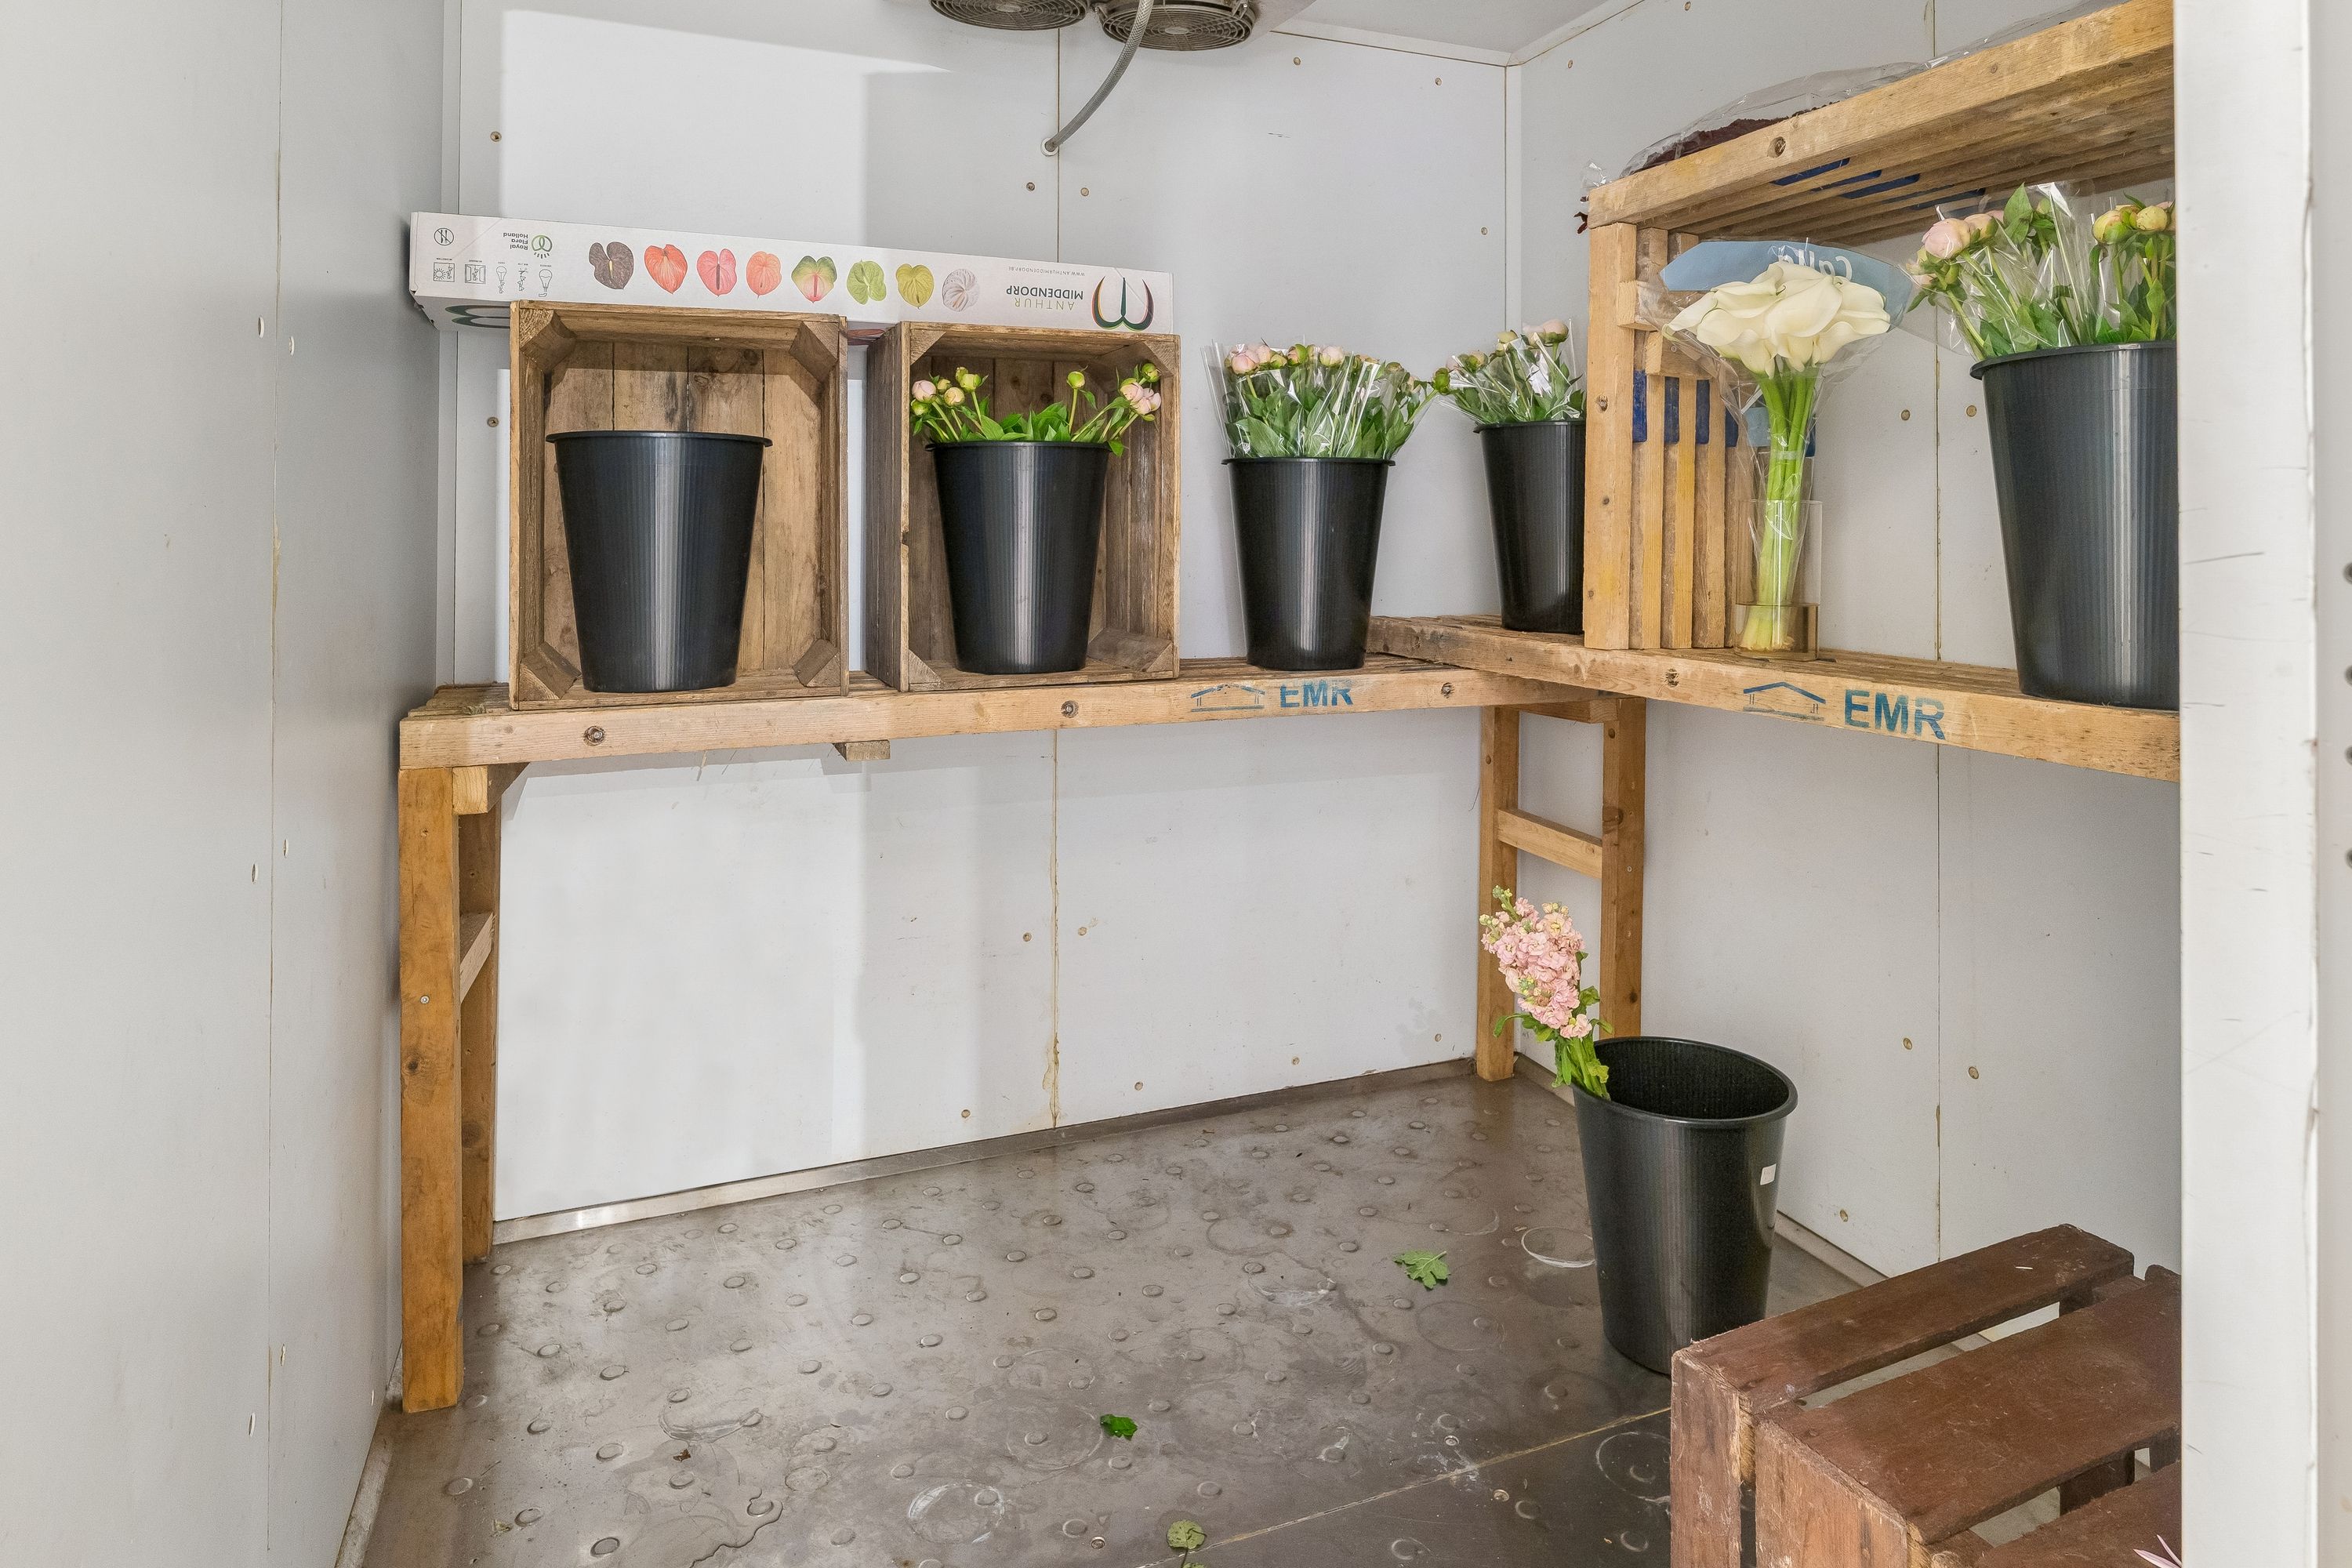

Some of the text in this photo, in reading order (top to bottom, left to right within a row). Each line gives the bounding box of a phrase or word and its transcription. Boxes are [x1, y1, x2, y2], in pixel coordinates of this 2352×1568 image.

[1006, 285, 1083, 300] MIDDENDORP
[1014, 297, 1075, 311] ANTHUR
[1279, 679, 1354, 709] EMR
[1845, 688, 1946, 740] EMR
